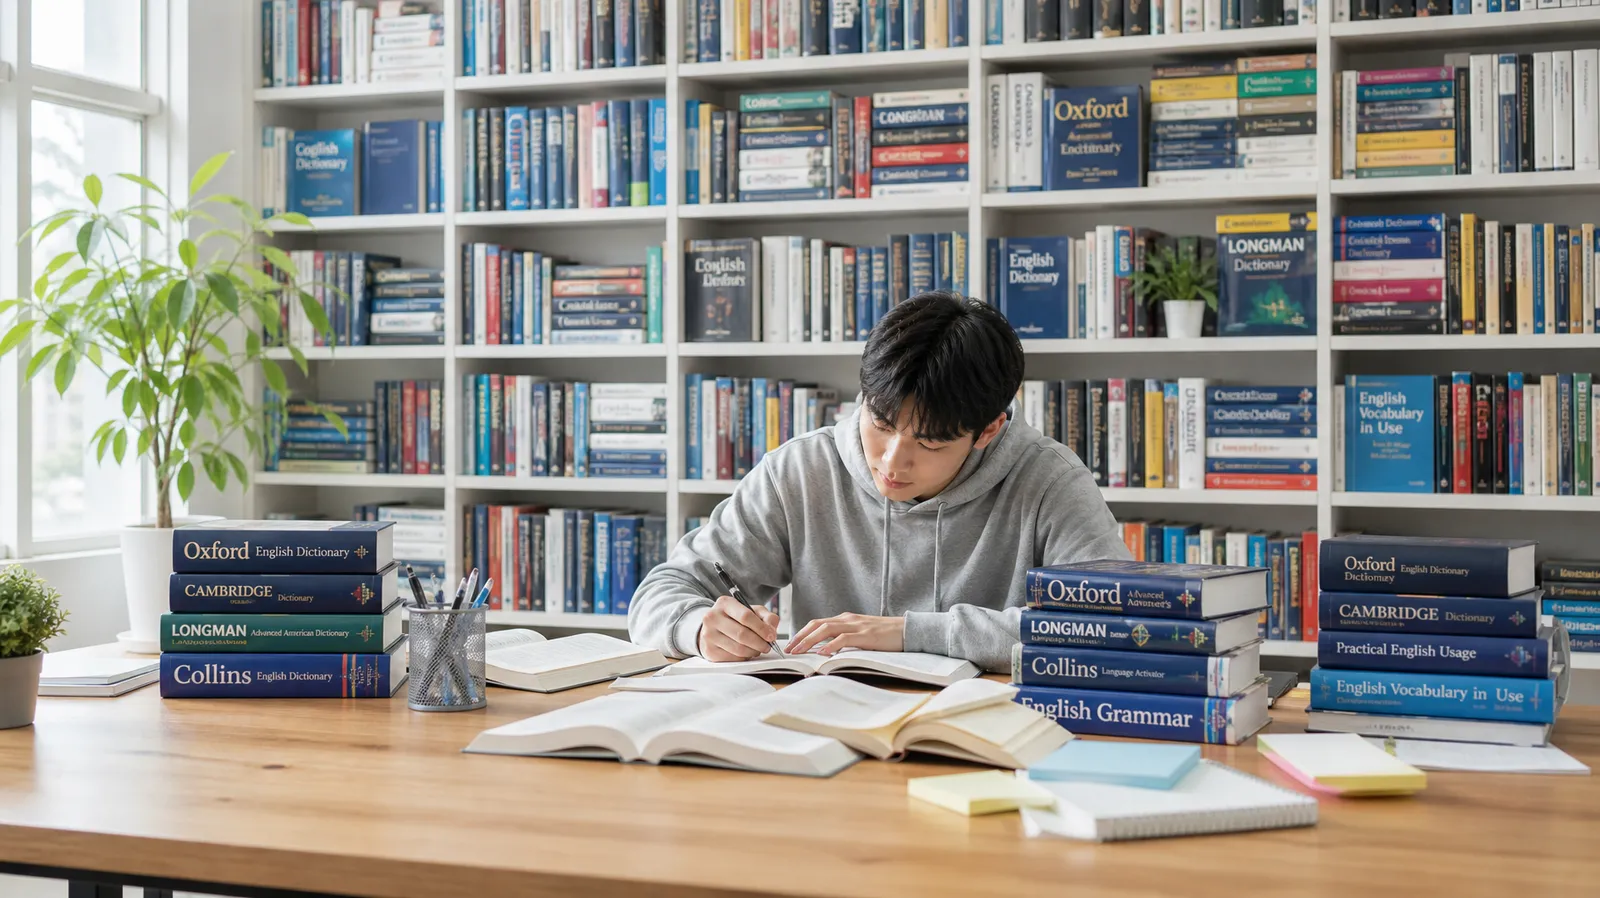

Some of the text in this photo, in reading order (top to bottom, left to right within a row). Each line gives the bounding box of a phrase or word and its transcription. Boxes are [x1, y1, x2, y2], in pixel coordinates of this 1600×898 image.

[1055, 97, 1128, 121] Oxford
[1228, 238, 1304, 253] LONGMAN
[1009, 252, 1054, 271] English
[1234, 259, 1291, 272] Dictionary
[1360, 391, 1406, 407] English
[1360, 407, 1424, 422] Vocabulary
[1360, 421, 1403, 434] in Use
[184, 541, 349, 560] Oxford English Dictionary
[1344, 556, 1470, 577] Oxford English Dictionary
[185, 584, 313, 603] CAMBRIDGE Dictionary
[1047, 580, 1122, 604] Oxford
[1339, 604, 1495, 624] CAMBRIDGE Dictionary
[172, 624, 247, 637] LONGMAN
[315, 629, 349, 638] Dictionary
[1031, 620, 1106, 638] LONGMAN
[1336, 642, 1476, 661] Practical English Usage
[174, 664, 333, 684] Collins English Dictionary
[1031, 657, 1098, 679] Collins
[1102, 667, 1134, 678] Language
[1336, 680, 1387, 697] English
[1390, 682, 1467, 702] Vocabulary
[1473, 687, 1487, 700] in
[1496, 688, 1524, 703] Use
[1097, 703, 1193, 728] Grammar
